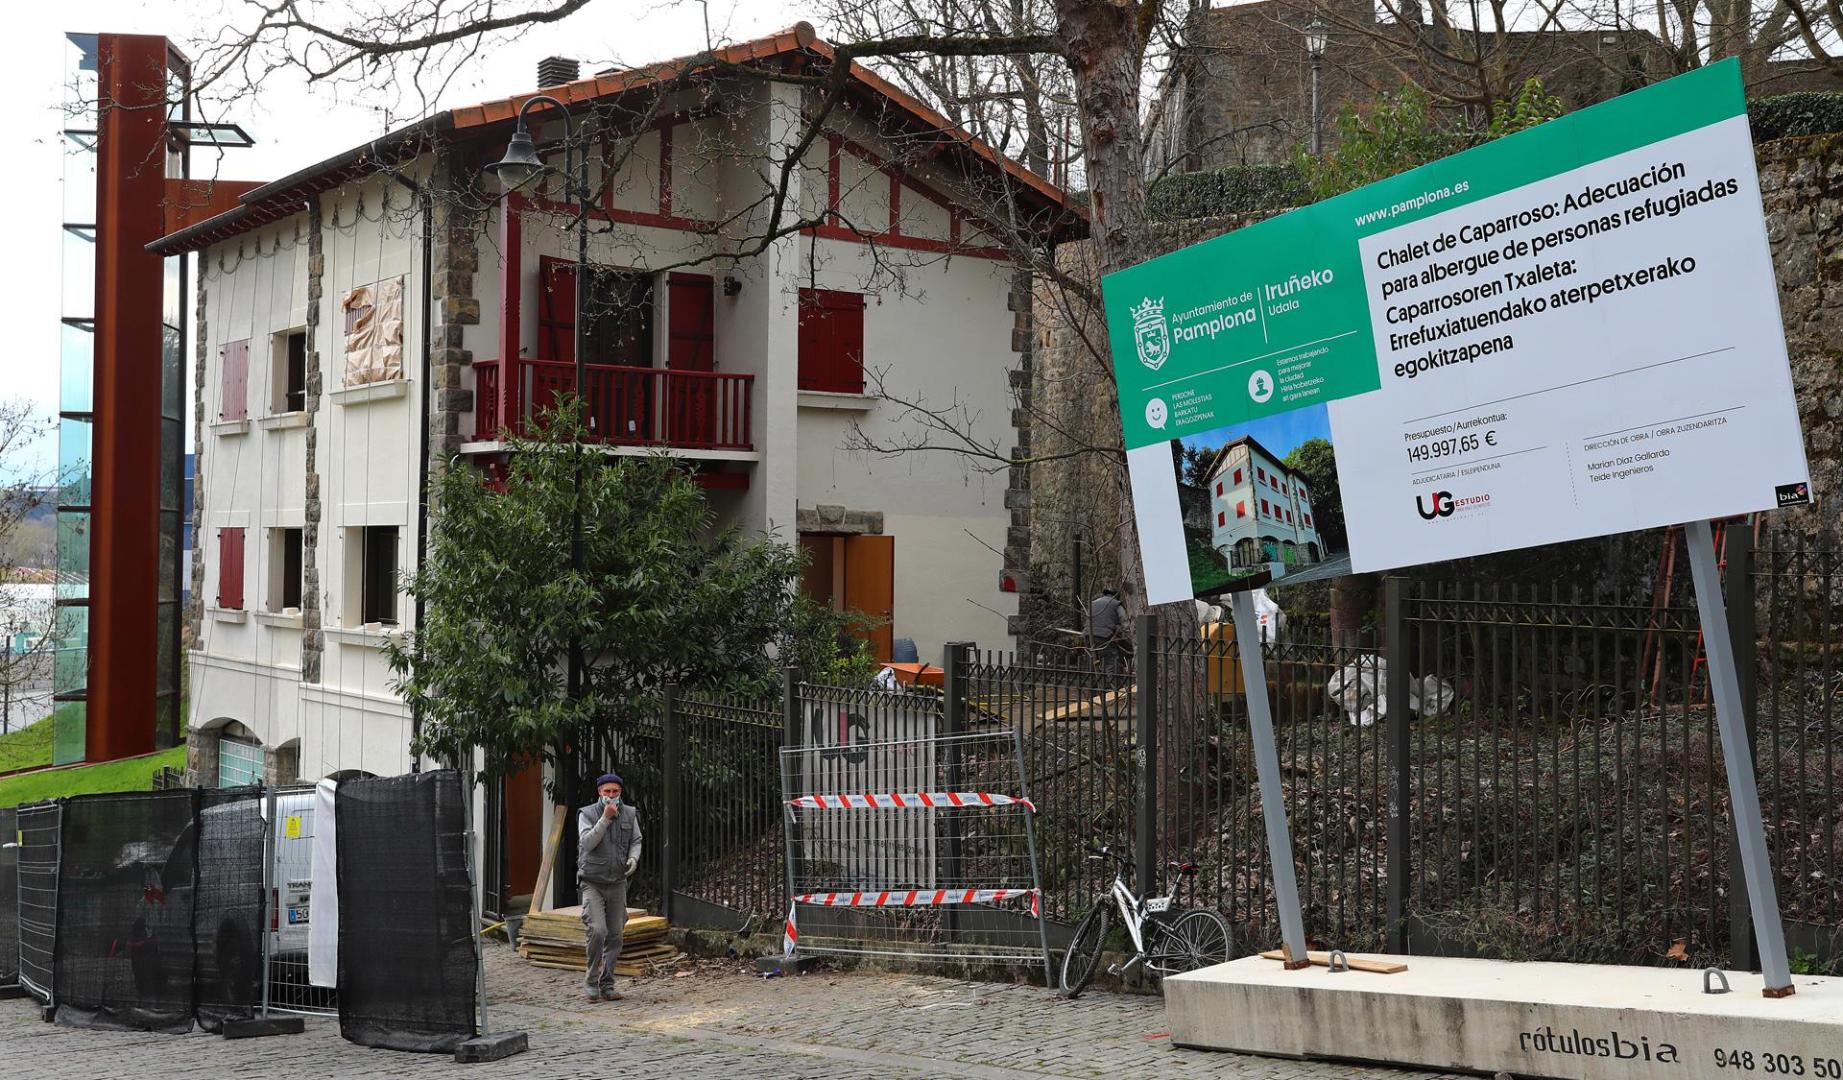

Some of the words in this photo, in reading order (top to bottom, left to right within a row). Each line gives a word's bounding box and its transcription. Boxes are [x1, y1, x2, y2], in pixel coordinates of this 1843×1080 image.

[1355, 181, 1470, 226] www.pamplona.es
[1377, 241, 1430, 269] Chalet
[1432, 233, 1456, 253] de
[1460, 202, 1560, 244] Caparroso:
[1564, 162, 1686, 214] Adecuación
[1382, 274, 1418, 300] para
[1421, 250, 1500, 285] albergue
[1502, 240, 1528, 260] de
[1531, 213, 1622, 256] personas
[1624, 178, 1738, 224] refugiadas
[1265, 269, 1334, 301] Iruñeko
[1386, 280, 1502, 324] Caparrosoren
[1504, 260, 1577, 291] Txaleta:
[1172, 296, 1238, 324] Ayuntamiento
[1240, 291, 1253, 301] de
[1268, 300, 1300, 316] Udala
[1390, 297, 1546, 351] Errefuxiatuendako
[1550, 256, 1696, 308] aterpetxerako
[1173, 307, 1256, 344] Pamplona
[1278, 367, 1290, 376] para
[1394, 335, 1514, 378] egokitzapena
[1286, 372, 1304, 382] ciudad
[1407, 434, 1479, 462] 149.997,65
[1485, 430, 1498, 446] €
[1584, 438, 1620, 451] DIRECCIÓN
[1620, 436, 1630, 444] DE
[1630, 432, 1649, 442] OBRA
[1656, 427, 1676, 438] OBRA
[1677, 416, 1728, 433] ZUZENDARITZA
[1588, 458, 1616, 471] Marian
[1634, 448, 1670, 462] Gallardo
[1589, 472, 1612, 483] Teide
[1612, 464, 1654, 480] Ingenieros
[1412, 471, 1456, 486] ADJUDICATARIA
[1455, 494, 1490, 507] ESTUDIO
[1714, 1048, 1755, 1072] 948
[1762, 1052, 1805, 1076] 303
[1814, 1058, 1843, 1079] 50
